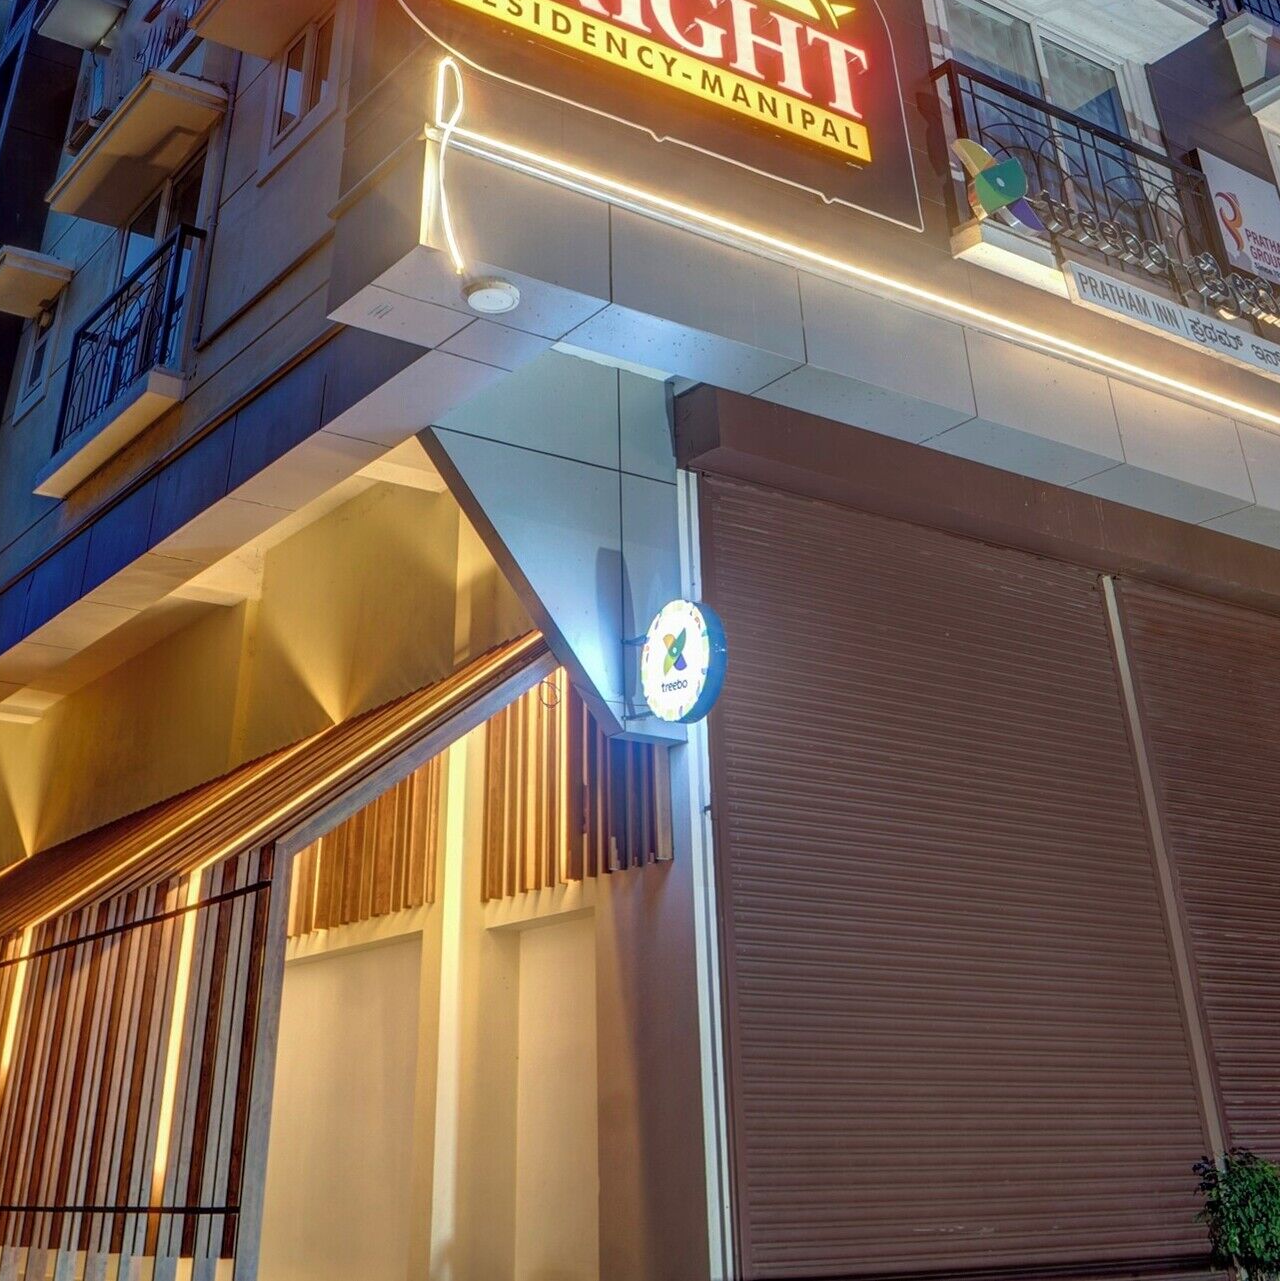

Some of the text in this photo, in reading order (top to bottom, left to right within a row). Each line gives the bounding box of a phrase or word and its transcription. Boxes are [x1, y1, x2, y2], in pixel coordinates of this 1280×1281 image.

[1032, 188, 1168, 272] treebo
[1078, 272, 1180, 329] PRATHAM INN
[661, 679, 688, 693] treebo
